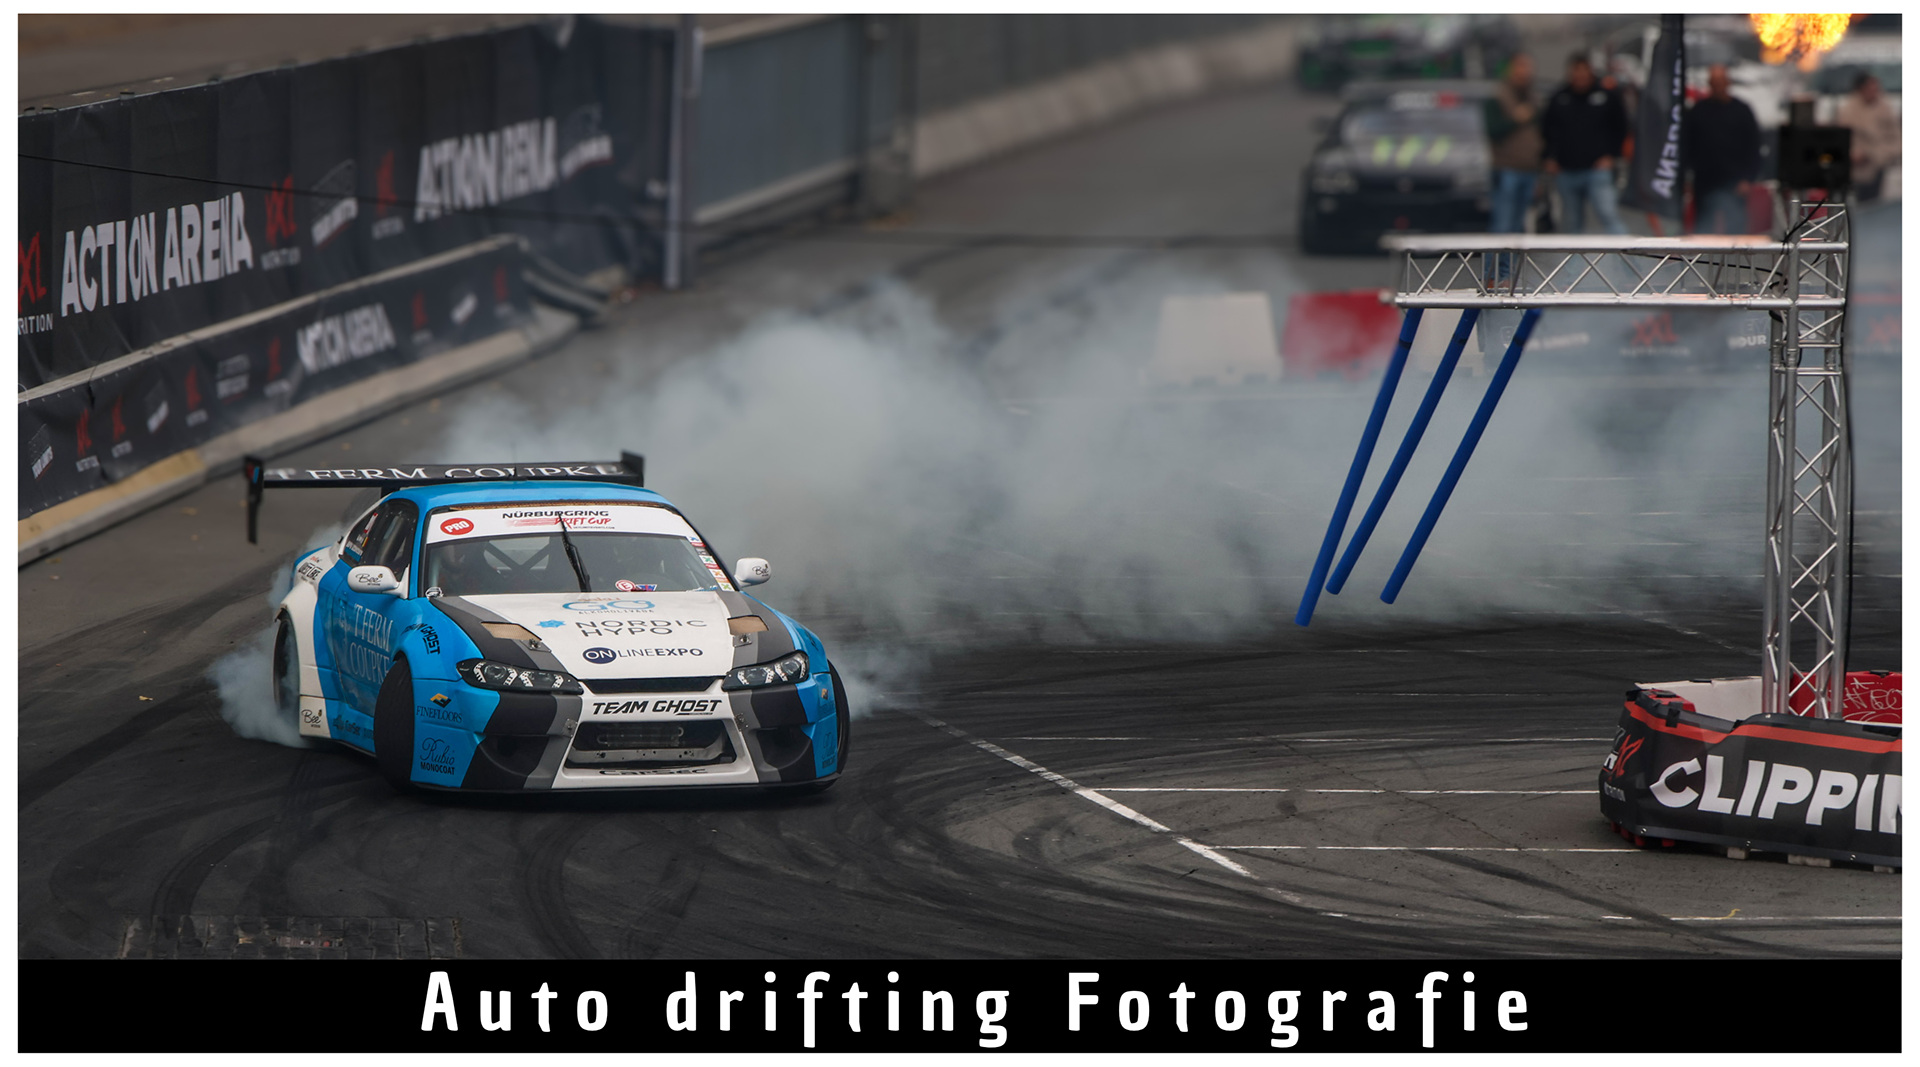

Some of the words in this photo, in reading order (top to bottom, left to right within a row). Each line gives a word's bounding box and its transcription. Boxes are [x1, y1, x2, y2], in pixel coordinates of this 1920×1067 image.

[61, 211, 159, 317] ACTION
[163, 191, 254, 291] ARENA
[305, 466, 428, 480] FERM
[502, 509, 609, 520] NÜRBURGRING
[444, 519, 470, 534] PRO
[554, 516, 588, 529] DRIFT
[587, 516, 612, 525] CUP
[362, 608, 394, 653] FERM
[575, 619, 707, 629] NORDIC
[580, 627, 673, 637] HYPO
[420, 626, 441, 655] GHOST
[416, 705, 462, 724] FINEFLOORS
[592, 700, 649, 715] TEAM
[651, 699, 722, 714] GHOST
[419, 737, 455, 766] Rubio
[420, 761, 455, 775] MONOCOAT
